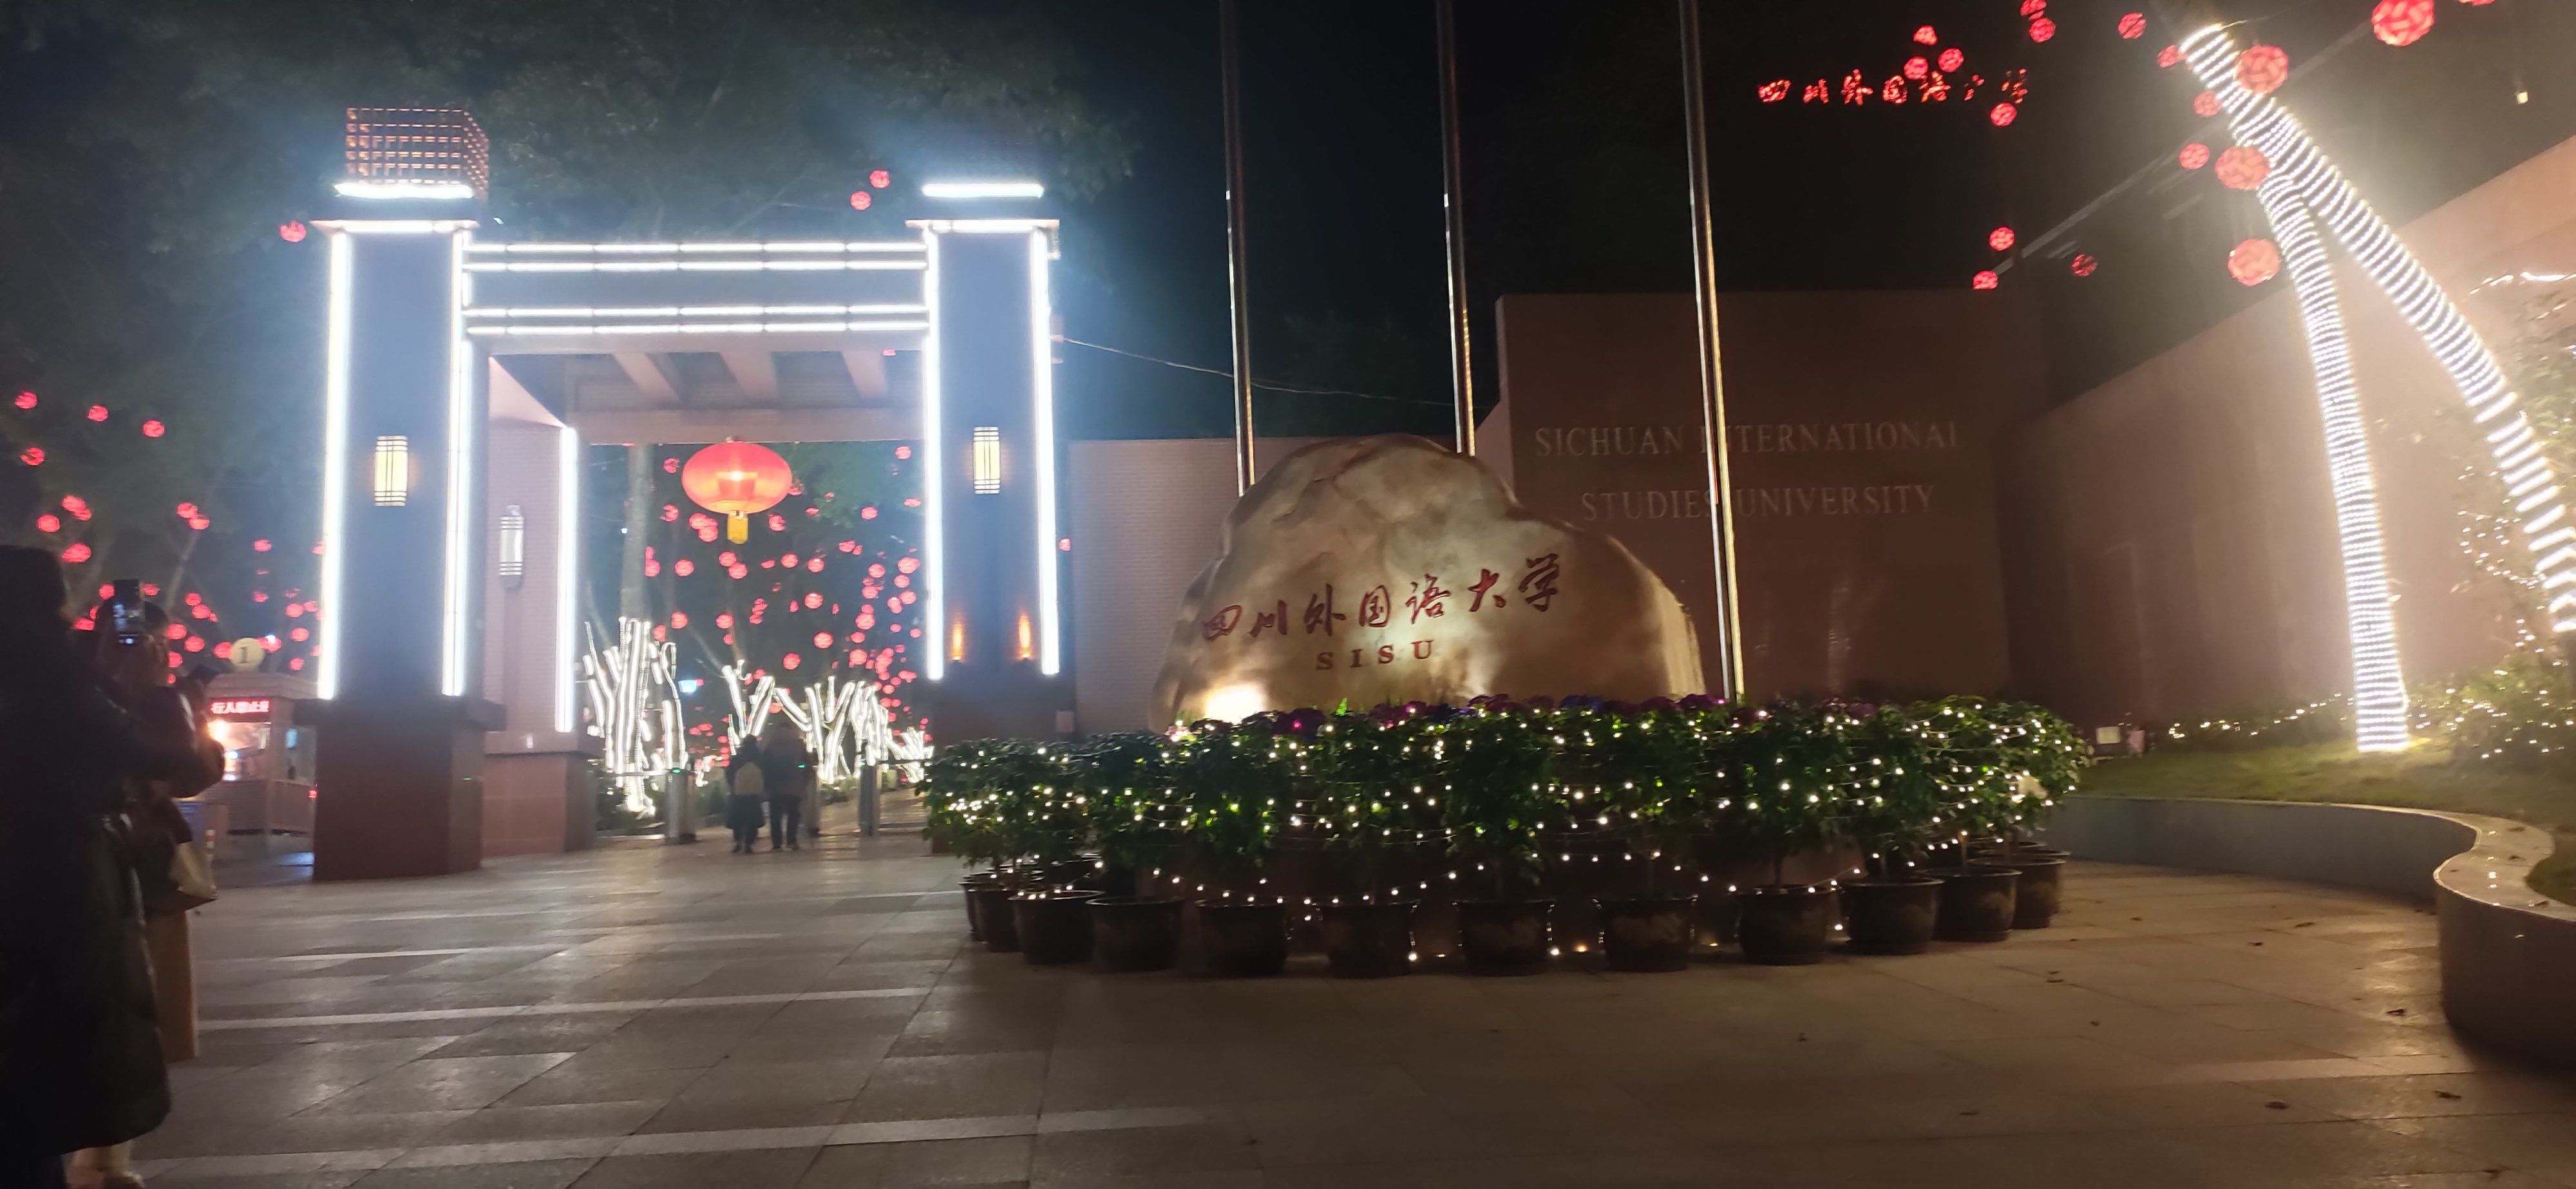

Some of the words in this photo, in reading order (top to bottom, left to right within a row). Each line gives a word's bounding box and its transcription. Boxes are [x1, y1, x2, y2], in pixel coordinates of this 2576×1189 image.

[1535, 425, 1683, 457] SICHUAN
[1700, 421, 1960, 453] ITERNATIONAL
[1736, 484, 1935, 517] UNIVERSITY
[1202, 552, 1560, 642] 四川外国语大学
[238, 645, 251, 664] 1
[1316, 640, 1434, 671] SISU
